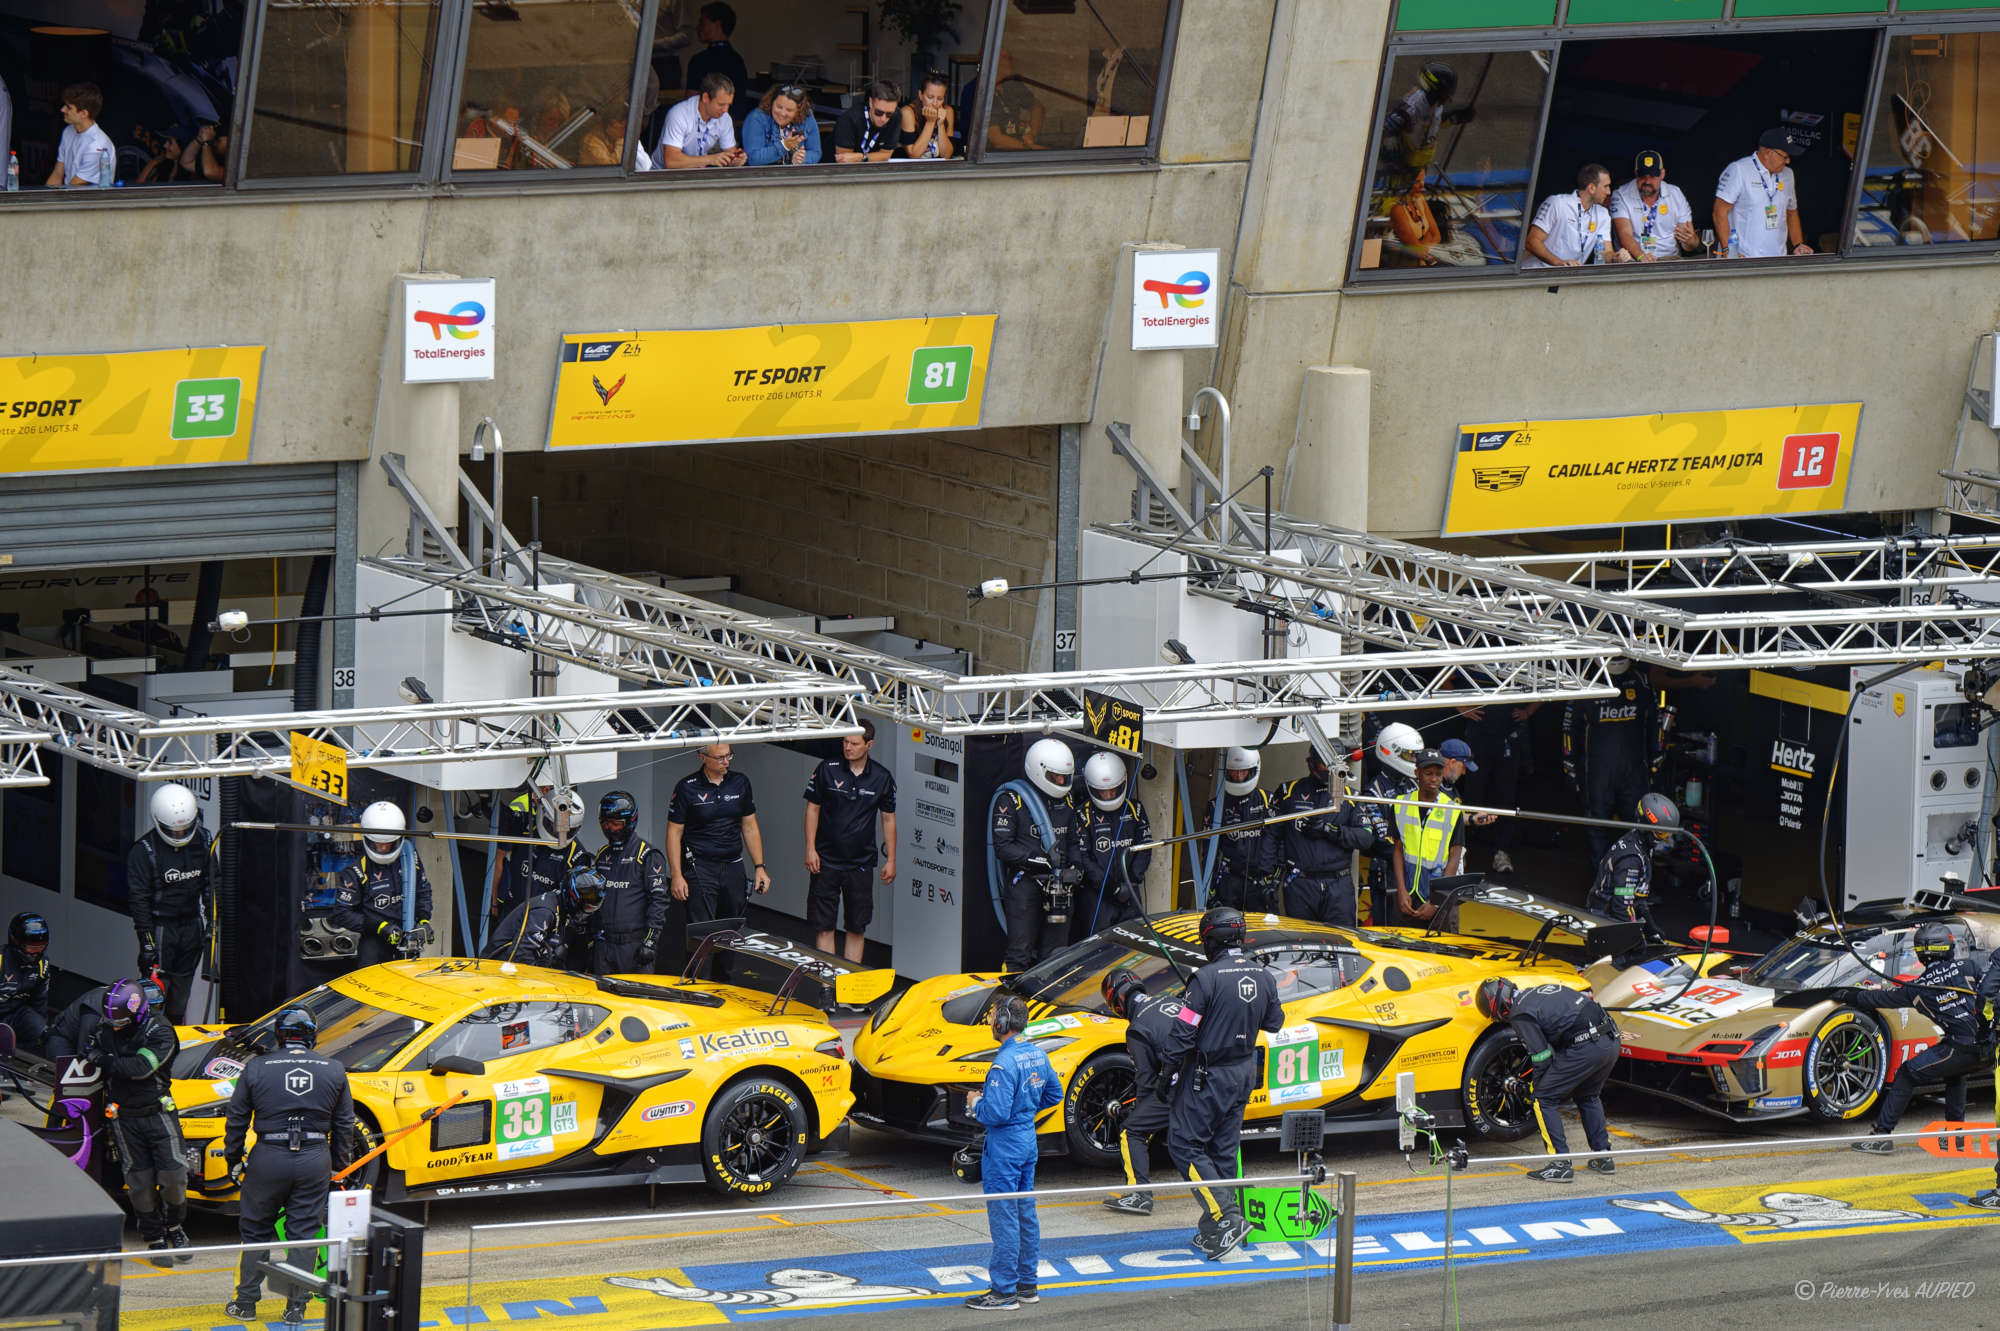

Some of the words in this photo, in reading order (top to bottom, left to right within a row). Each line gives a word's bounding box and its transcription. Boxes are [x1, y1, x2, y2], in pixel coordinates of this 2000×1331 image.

[1142, 315, 1210, 327] TotalEnergies
[413, 347, 486, 360] TotalEnergies
[734, 369, 758, 387] TF
[759, 365, 826, 385] SPORT
[924, 361, 956, 390] 81
[727, 393, 765, 403] Corvette
[766, 390, 783, 401] Z06
[10, 397, 82, 419] SPORT
[186, 394, 226, 423] 33
[18, 424, 36, 435] Z06
[1548, 460, 1625, 479] CADILLAC
[1626, 457, 1679, 475] HERTZ
[1681, 454, 1727, 472] TEAM
[1727, 452, 1764, 471] JOTA
[1792, 446, 1826, 478] 12
[1616, 479, 1650, 491] Cadillac
[0, 572, 193, 592] CORVETTE
[1057, 632, 1077, 650] 37
[335, 669, 355, 688] 38
[1121, 710, 1142, 722] SPORT
[1600, 704, 1638, 720] Hertz
[924, 730, 963, 756] Sonangol
[1108, 724, 1141, 753] #81
[326, 752, 344, 767] SPORT
[1771, 740, 1816, 773] Hertz
[311, 769, 344, 797] #33
[1781, 777, 1796, 790] Mobil
[1780, 792, 1803, 804] JOTA
[1780, 803, 1802, 817] BRADY
[1110, 838, 1134, 848] SPORT
[167, 872, 181, 882] TF
[606, 880, 630, 889] SPORT
[376, 897, 390, 906] TF
[344, 976, 441, 1012] CORVETTE
[1242, 983, 1254, 996] TF
[1936, 990, 1958, 1003] Hertz
[699, 1026, 791, 1054] Keating
[1712, 1032, 1734, 1040] Mobil
[1323, 1051, 1340, 1065] LM
[1620, 1046, 1632, 1055] TA
[1771, 1049, 1803, 1061] JOTA
[264, 1058, 330, 1066] CORVETTE
[1276, 1045, 1310, 1085] 81
[799, 1064, 841, 1076] GOODYEAR
[1321, 1064, 1342, 1079] GT3
[289, 1076, 310, 1089] TF
[1070, 1065, 1096, 1103] EAGLE
[552, 1095, 564, 1103] FIA
[760, 1084, 794, 1106] EAGLE
[1280, 1084, 1311, 1099] WEC
[1469, 1077, 1481, 1116] EAGLE
[1766, 1099, 1799, 1107] MICHELIN
[503, 1097, 544, 1140] 33
[555, 1104, 573, 1119] LM
[554, 1118, 576, 1133] GT3
[508, 1139, 542, 1154] WEC
[427, 1151, 494, 1170] GOODYEAR
[1248, 1198, 1267, 1232] 81
